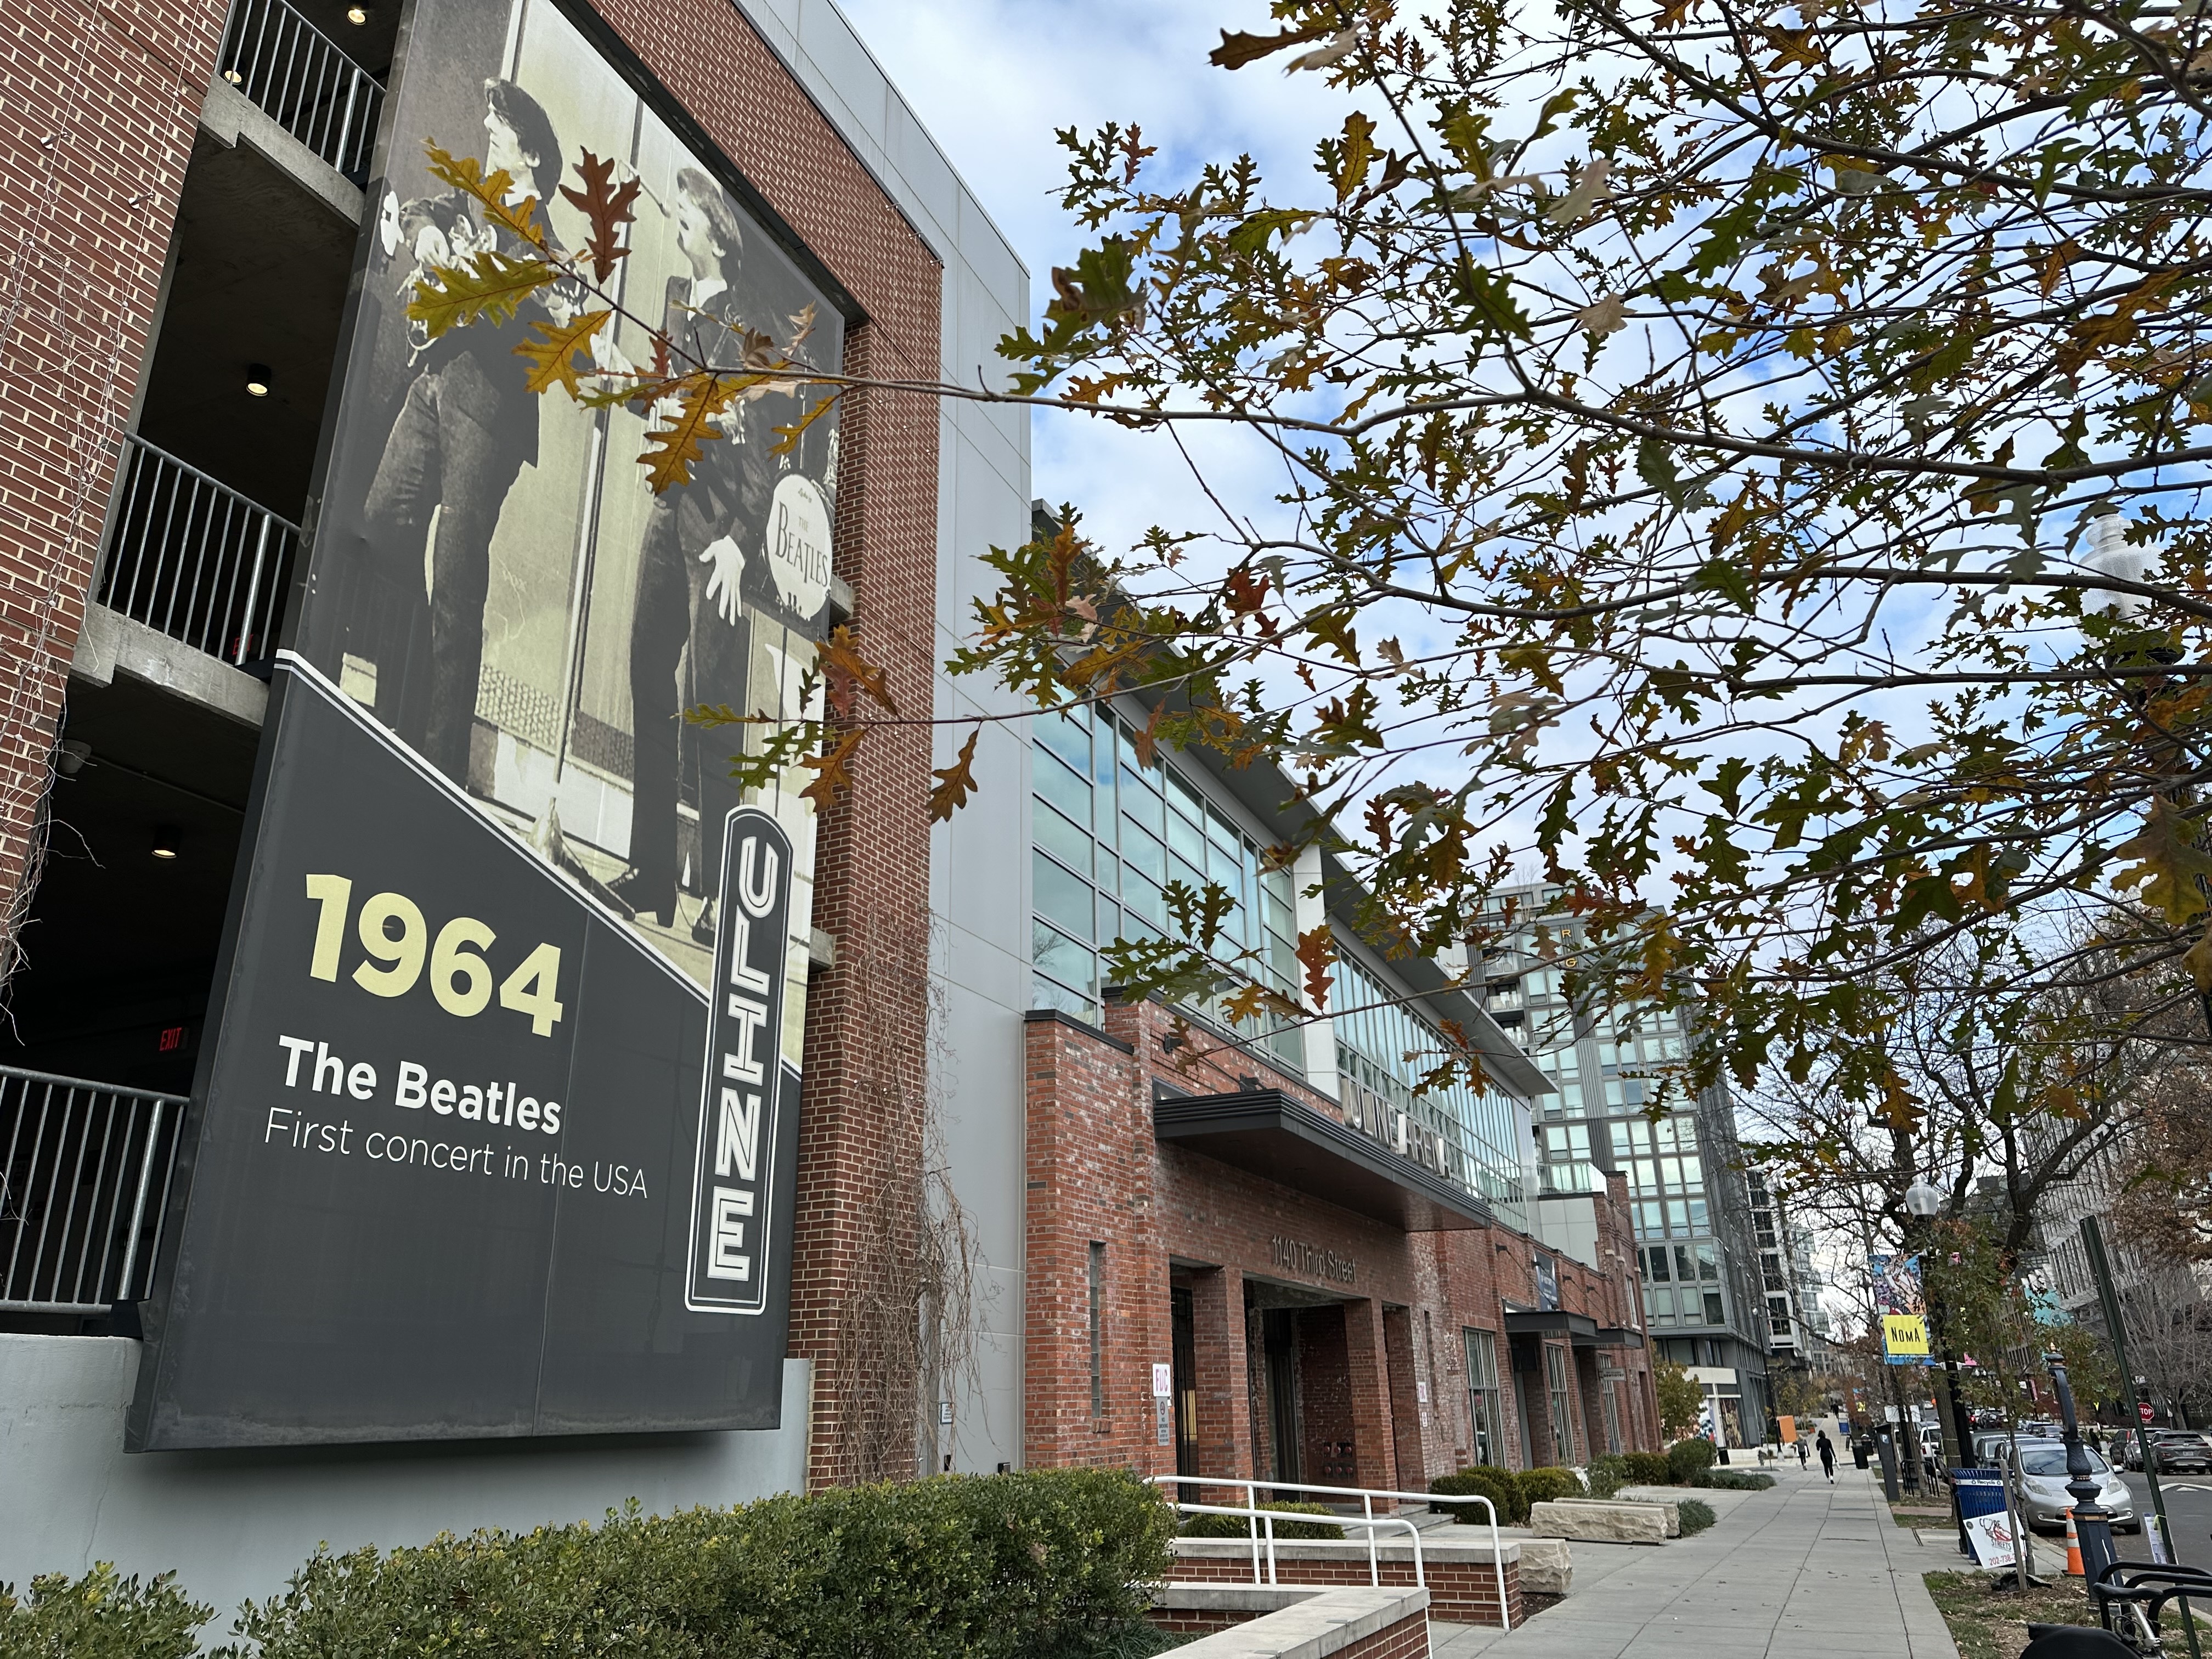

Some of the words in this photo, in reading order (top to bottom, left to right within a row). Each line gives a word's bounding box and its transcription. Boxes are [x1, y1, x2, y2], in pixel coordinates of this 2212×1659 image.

[775, 500, 827, 587] BEATLES
[306, 874, 563, 1037] 1964
[159, 1027, 182, 1051] EXIT
[707, 836, 778, 1282] ULINE
[279, 1035, 377, 1100] The
[395, 1060, 561, 1135] Beatles
[265, 1107, 353, 1155] First
[366, 1132, 494, 1176] concert
[504, 1146, 528, 1180] in
[540, 1153, 584, 1189] the
[594, 1161, 647, 1199] USA
[1272, 1234, 1297, 1269] 1140
[1299, 1242, 1325, 1276] Third
[1328, 1250, 1357, 1283] Street
[1155, 1369, 1168, 1392] FDC
[1991, 1538, 2012, 1550] STREETS
